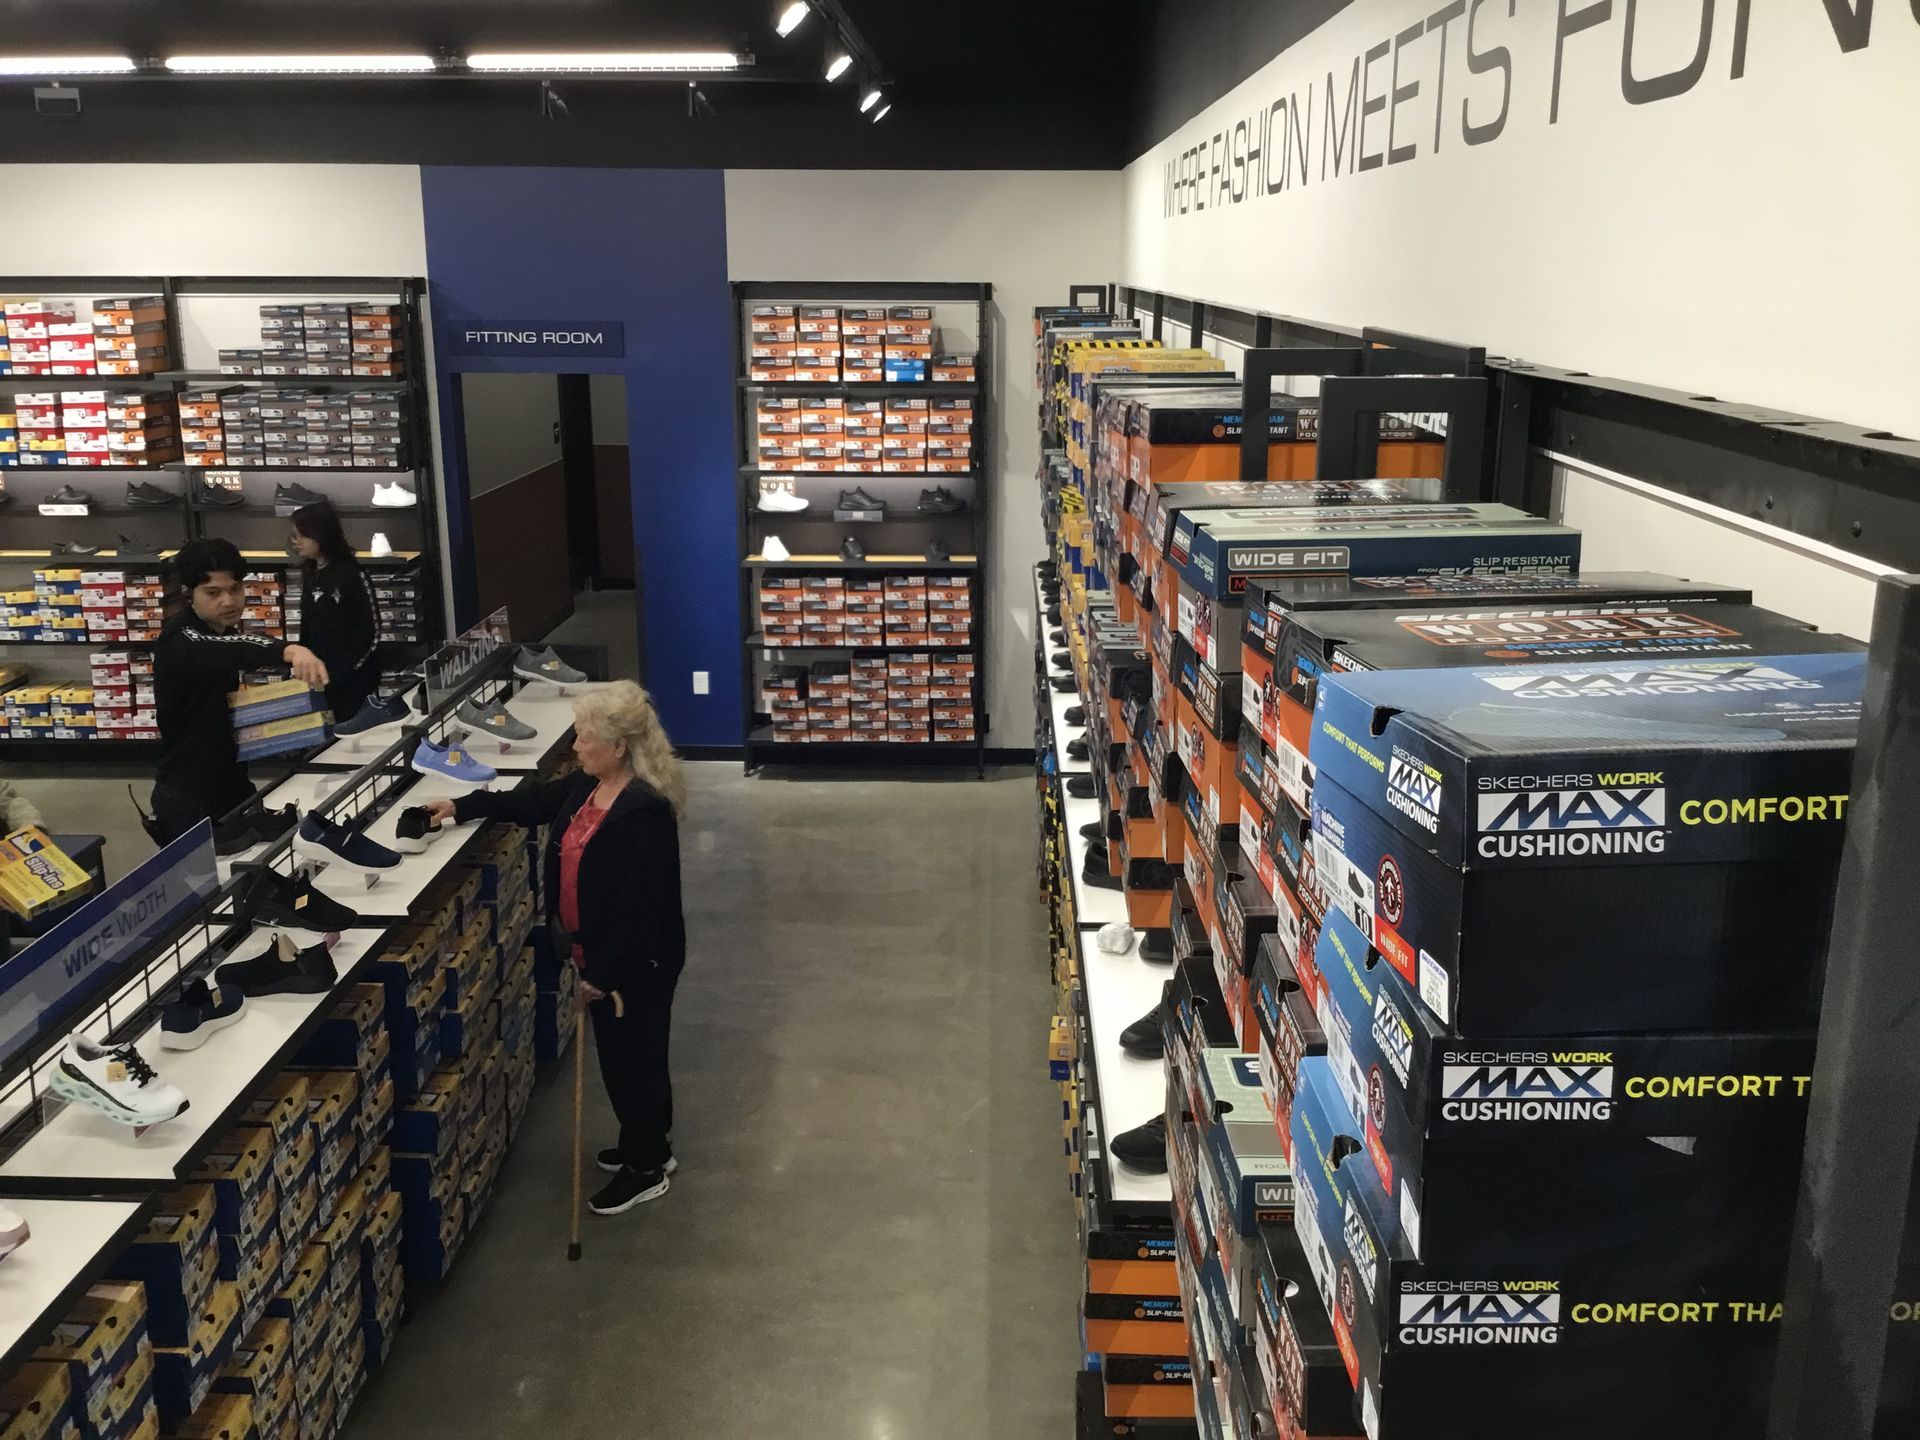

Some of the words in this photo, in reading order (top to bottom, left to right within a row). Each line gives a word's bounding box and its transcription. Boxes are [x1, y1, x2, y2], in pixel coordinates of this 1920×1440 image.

[1163, 141, 1207, 219] WHERE
[1209, 83, 1312, 208] FASHION
[1322, 0, 1516, 182] MEETS
[465, 331, 537, 344] FITTING
[542, 332, 603, 344] ROOM
[1234, 552, 1294, 566] WIDE
[1303, 551, 1344, 565] FIT
[1473, 557, 1500, 566] SLIP
[1502, 556, 1571, 565] RESISTANT
[1395, 607, 1669, 622] SKECHERS
[1415, 615, 1701, 636] WORK
[1445, 629, 1720, 643] FOOTWEAR
[1504, 639, 1623, 650] MEMORY
[1639, 637, 1721, 646] FOAM
[1512, 680, 1824, 698] CUSHIONING
[1322, 721, 1344, 745] COMFORT
[1391, 744, 1424, 771] SKECHERS
[1423, 763, 1443, 783] WORK
[1389, 760, 1440, 813] MAX
[1478, 773, 1594, 790] SKECHERS
[1597, 771, 1665, 786] WORK
[1386, 787, 1437, 834] CUSHIONING
[1482, 788, 1661, 831] MAX
[1680, 794, 1849, 825] COMFORT
[1477, 830, 1666, 858] CUSHIONING
[24, 856, 65, 890] Slip-ins
[63, 924, 114, 978] WIDE
[116, 884, 167, 936] WIDTH
[1357, 906, 1370, 937] 10
[1375, 1002, 1411, 1072] MAX
[1371, 1022, 1408, 1090] CUSHIONING
[1443, 1052, 1549, 1064] SKECHERS
[1552, 1052, 1613, 1063] WORK
[1447, 1066, 1608, 1098] MAX
[1625, 1075, 1783, 1099] COMFORT
[1441, 1100, 1611, 1121] CUSHIONING
[1400, 1281, 1500, 1292] SKECHERS
[1503, 1280, 1560, 1291] WORK
[1404, 1294, 1555, 1324] MAX
[1571, 1302, 1720, 1324] COMFORT
[1398, 1326, 1558, 1345] CUSHIONING
